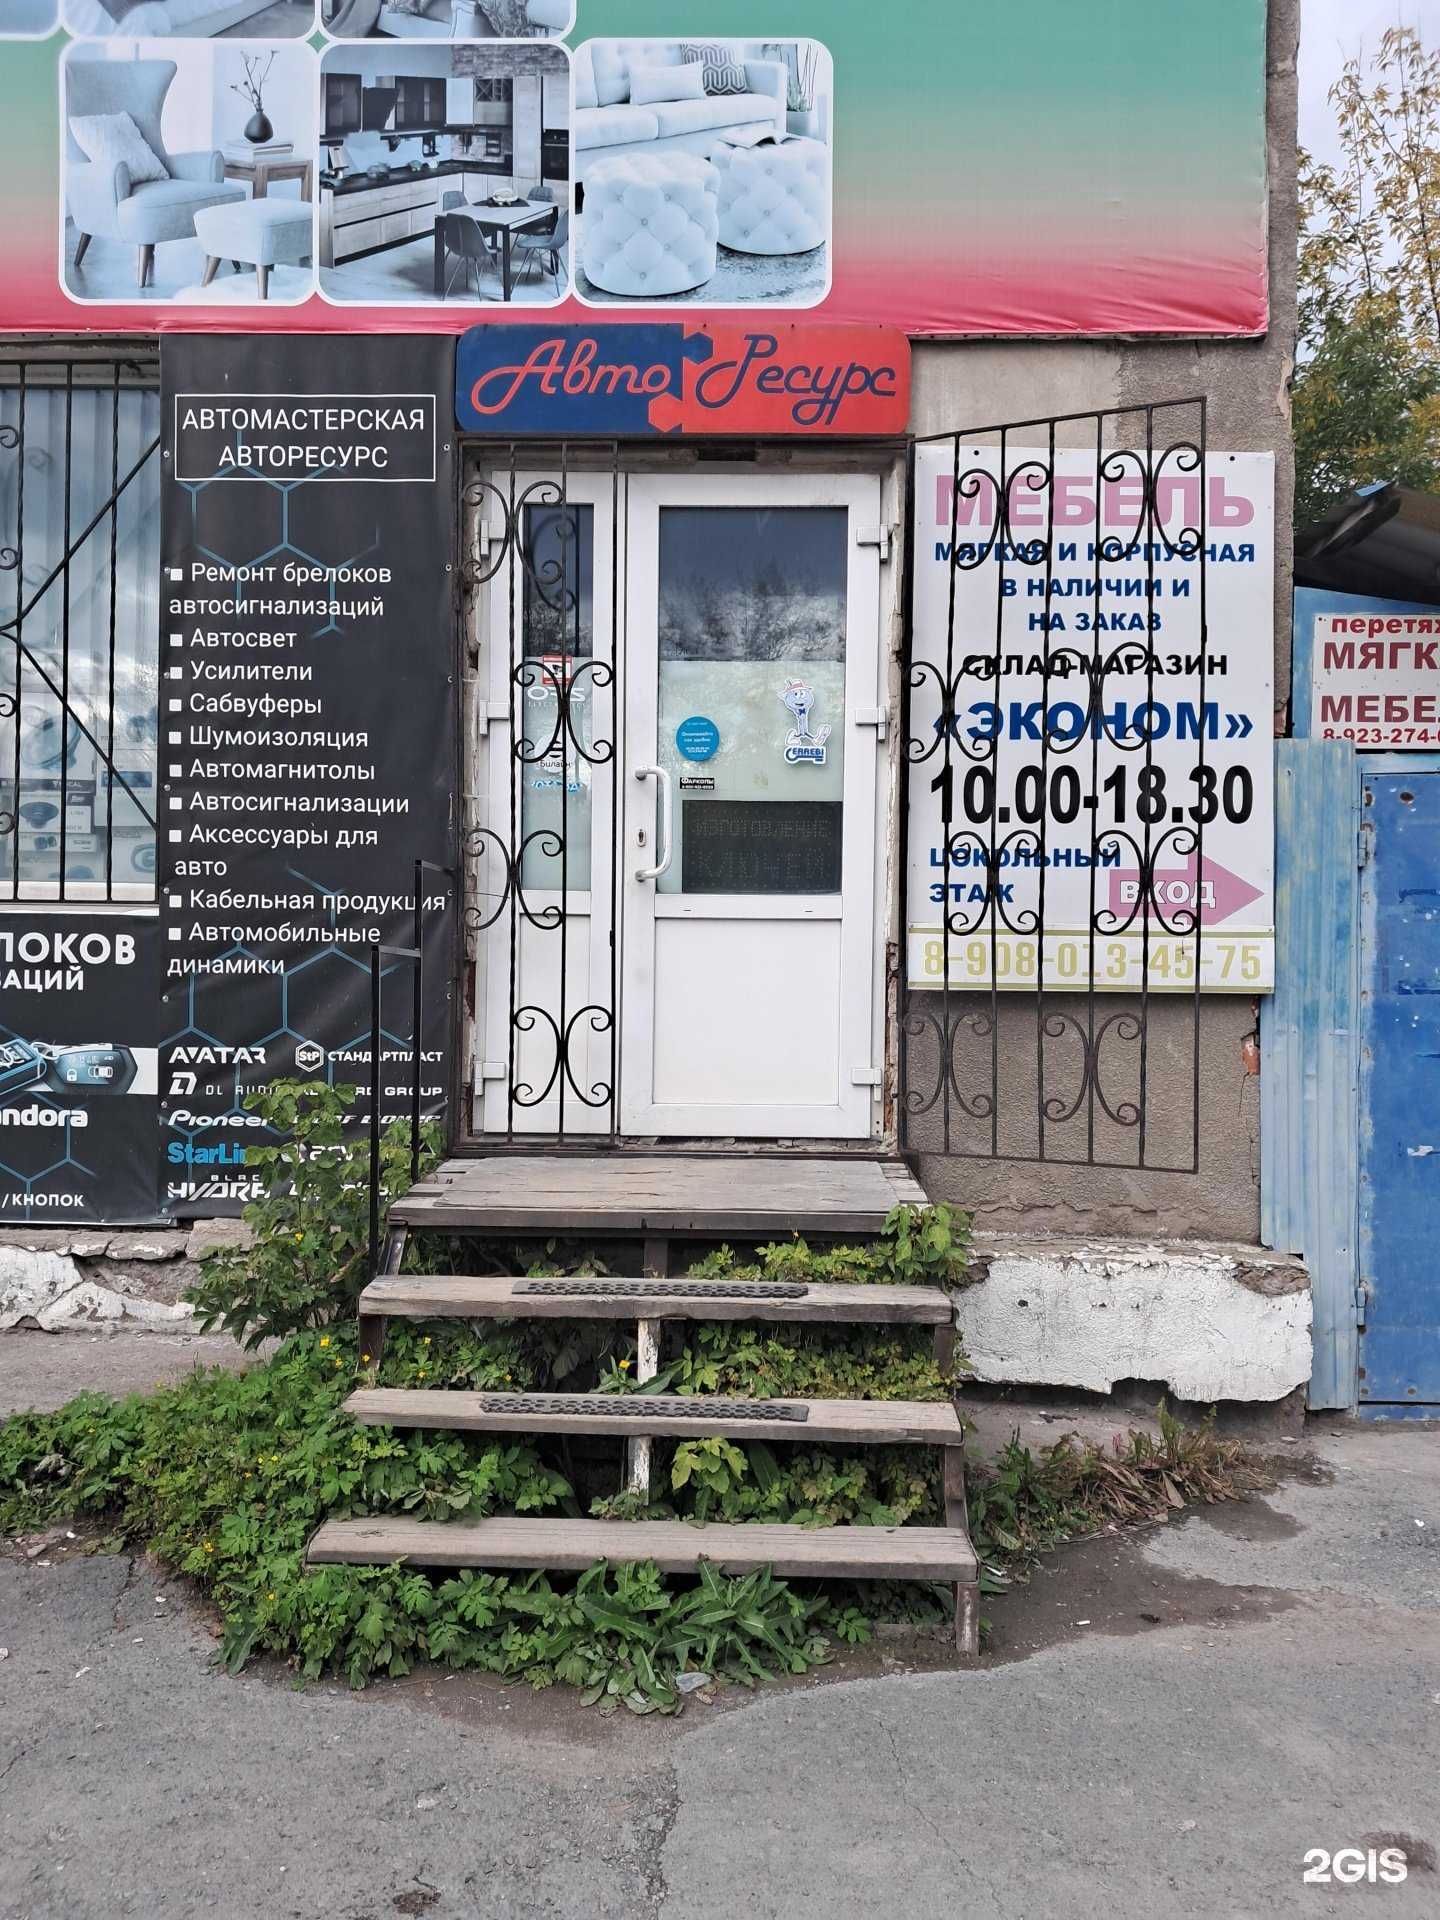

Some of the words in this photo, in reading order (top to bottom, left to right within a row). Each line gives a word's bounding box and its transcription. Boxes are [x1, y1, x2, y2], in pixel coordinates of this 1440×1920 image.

[471, 339, 672, 414] Авто
[695, 334, 897, 426] Ресурс
[182, 408, 425, 430] АВТОМАСТЕРСКАЯ
[218, 446, 388, 467] АВТОРЕСУРС
[935, 474, 1255, 528] МЕБЕЛЬ
[1058, 542, 1077, 561] И
[191, 563, 276, 582] Ремонт
[283, 563, 391, 586] брелоков
[1000, 578, 1017, 597] В
[1027, 578, 1162, 598] НАЛИЧИИ
[1172, 579, 1190, 597] И
[169, 596, 384, 619] автосигнализаций
[1028, 612, 1066, 631] НА
[1075, 611, 1162, 632] ЗАКАЗ
[1331, 618, 1440, 639] перетя
[190, 628, 297, 647] Автосвет
[1323, 641, 1440, 670] МЯГК
[190, 660, 312, 680] Усилители
[189, 694, 322, 717] Сабвуферы
[1320, 695, 1440, 723] МЕБЕ
[932, 701, 1254, 741] «ЭКОНОМ»
[189, 726, 368, 749] Шумоизоляция
[1322, 728, 1440, 743] 8-923-274-
[189, 759, 375, 779] Автомагнитолы
[189, 792, 409, 815] Автосигнализации
[931, 764, 1254, 825] 10.00-18.30
[189, 824, 328, 847] Аксессуары
[336, 829, 378, 847] для
[175, 860, 227, 875] авто
[190, 889, 314, 909] Кабельная
[189, 922, 380, 942] Автомобильные
[168, 957, 284, 975] динамики
[0, 966, 84, 993] АЦИЙ
[169, 1047, 266, 1064] AVATAR
[0, 1104, 88, 1127] ndora
